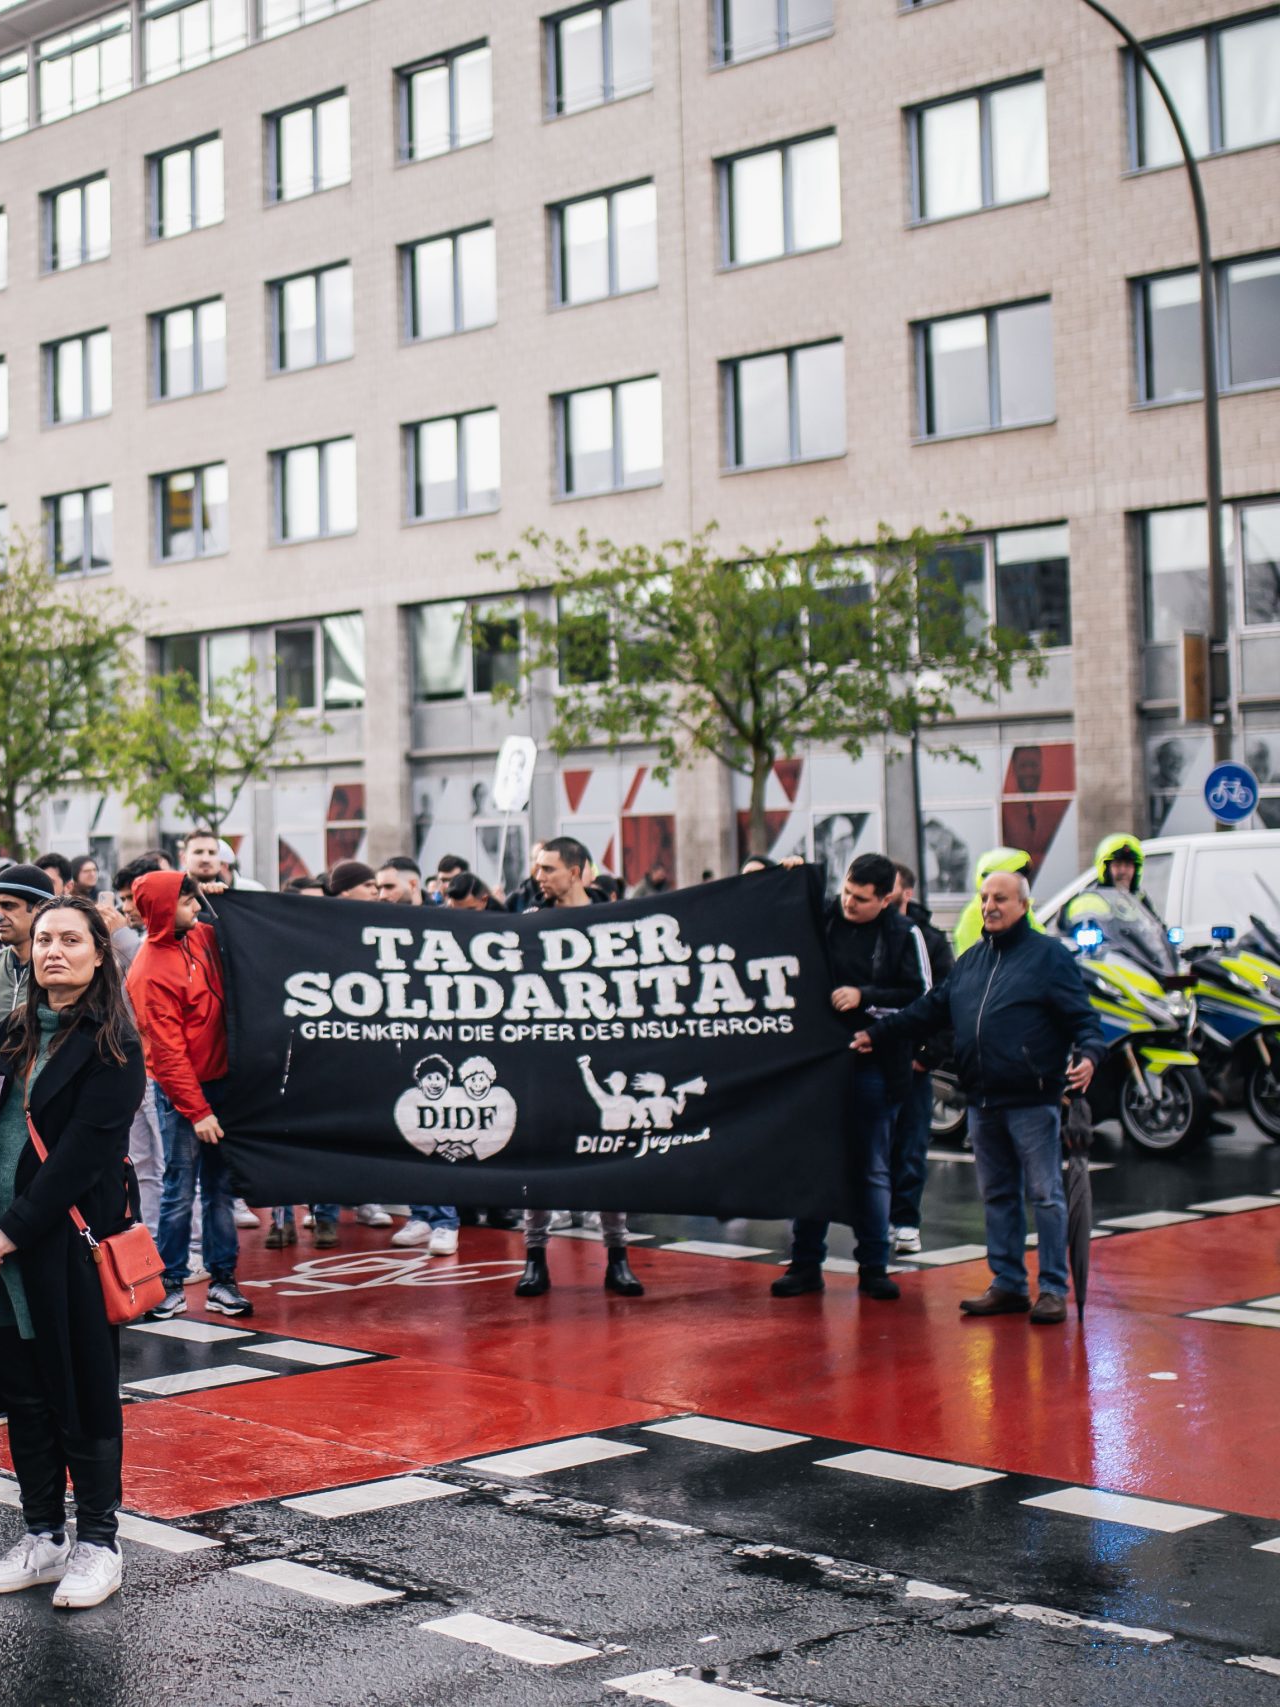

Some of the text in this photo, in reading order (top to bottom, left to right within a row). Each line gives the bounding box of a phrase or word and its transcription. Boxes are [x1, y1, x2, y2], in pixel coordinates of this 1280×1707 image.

[362, 913, 691, 972] TAG DER
[283, 944, 800, 1020] SOLIDARITÄT
[300, 1016, 795, 1042] GEDENKEN AN DIE OPFER DES NSU-TERRORS
[416, 1105, 498, 1131] DIDF
